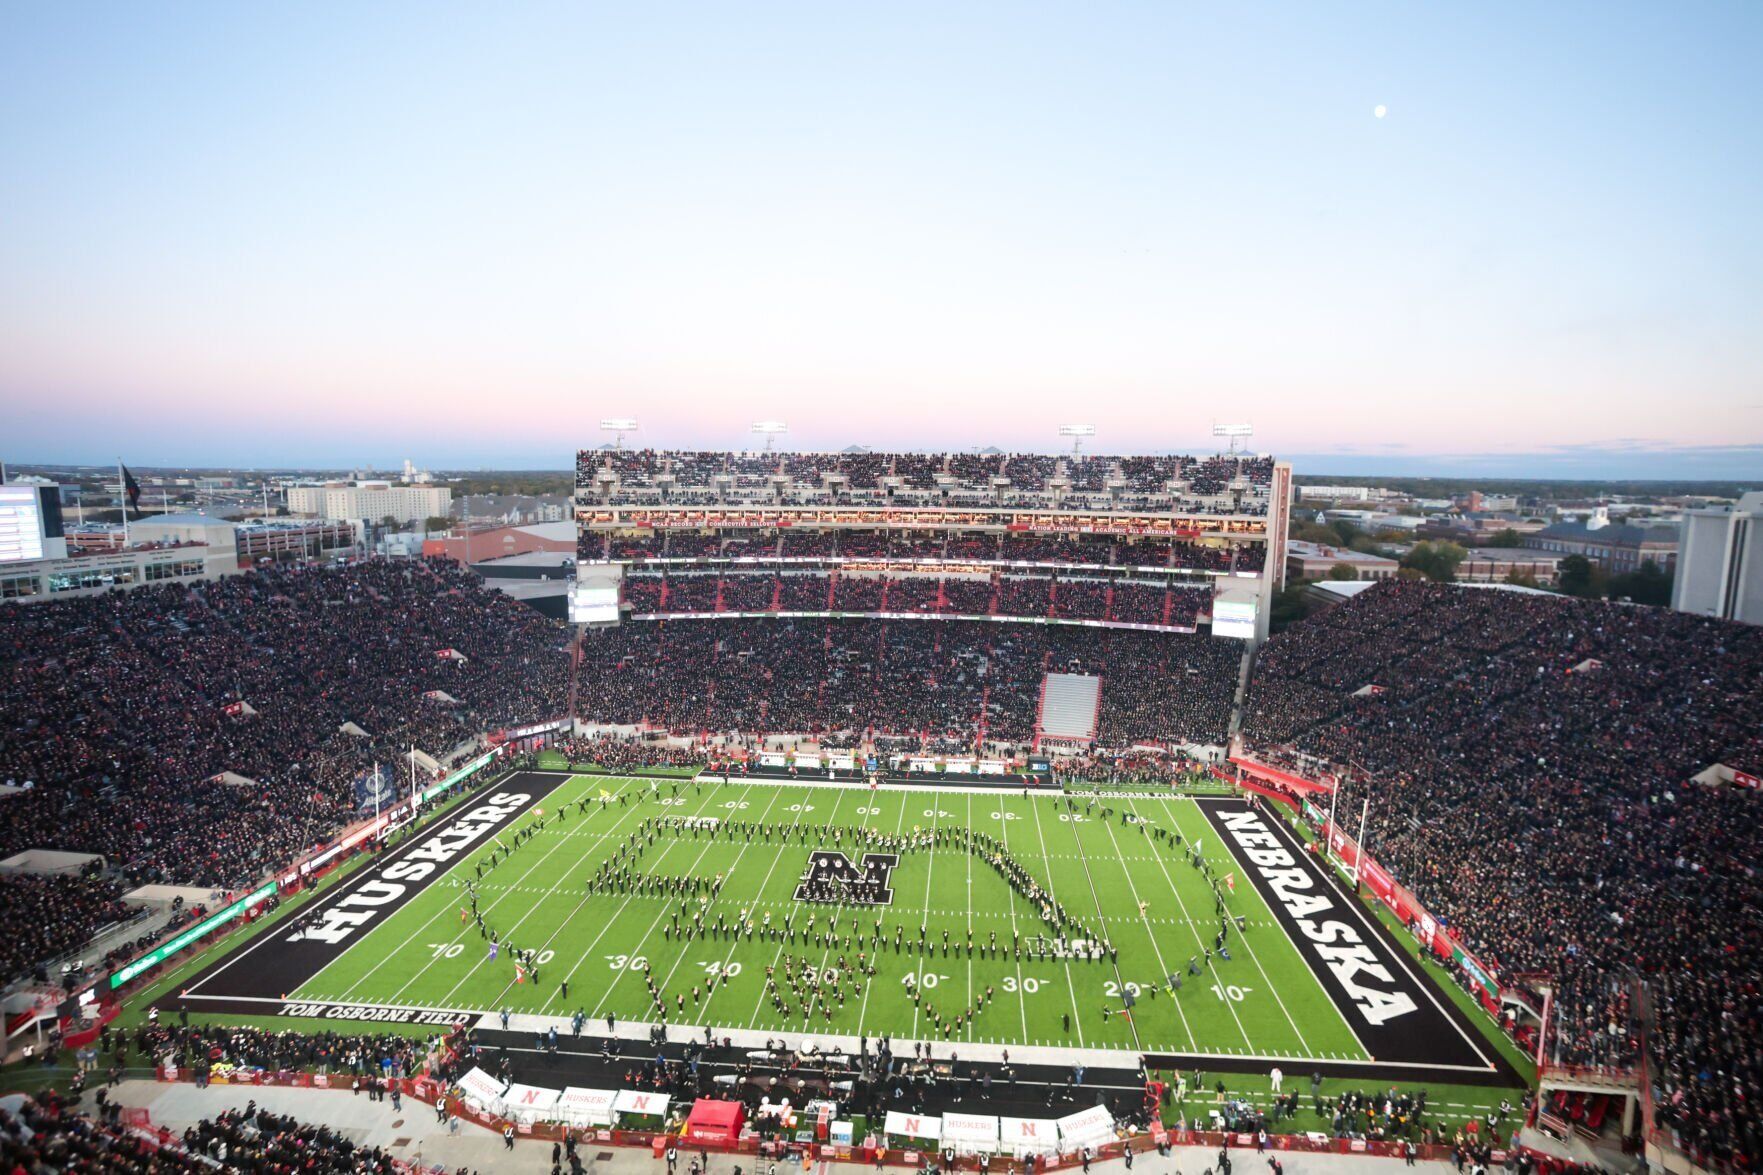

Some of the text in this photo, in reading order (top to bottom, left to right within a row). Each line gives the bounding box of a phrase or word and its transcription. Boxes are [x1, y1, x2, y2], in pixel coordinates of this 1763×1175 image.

[856, 806, 881, 815] 50
[285, 792, 532, 944] HUSKERS
[792, 850, 900, 905] N
[1216, 810, 1418, 1026] NEBRASKA
[432, 943, 465, 958] 10
[609, 954, 648, 971] 30
[704, 960, 742, 977] 40
[901, 971, 938, 989] 40
[1002, 976, 1039, 993] 30
[1103, 980, 1141, 998] 20
[1210, 984, 1244, 1001] 10
[278, 1003, 471, 1026] TOM OSBORNE FIELD
[465, 1073, 496, 1098] HUSKERS
[520, 1089, 540, 1105] N
[565, 1093, 608, 1105] HUSKERS
[632, 1095, 651, 1110] N
[904, 1117, 920, 1133] N
[948, 1119, 993, 1131] HUSKERS
[1021, 1122, 1037, 1137] N
[1064, 1113, 1106, 1131] HUSKERS
